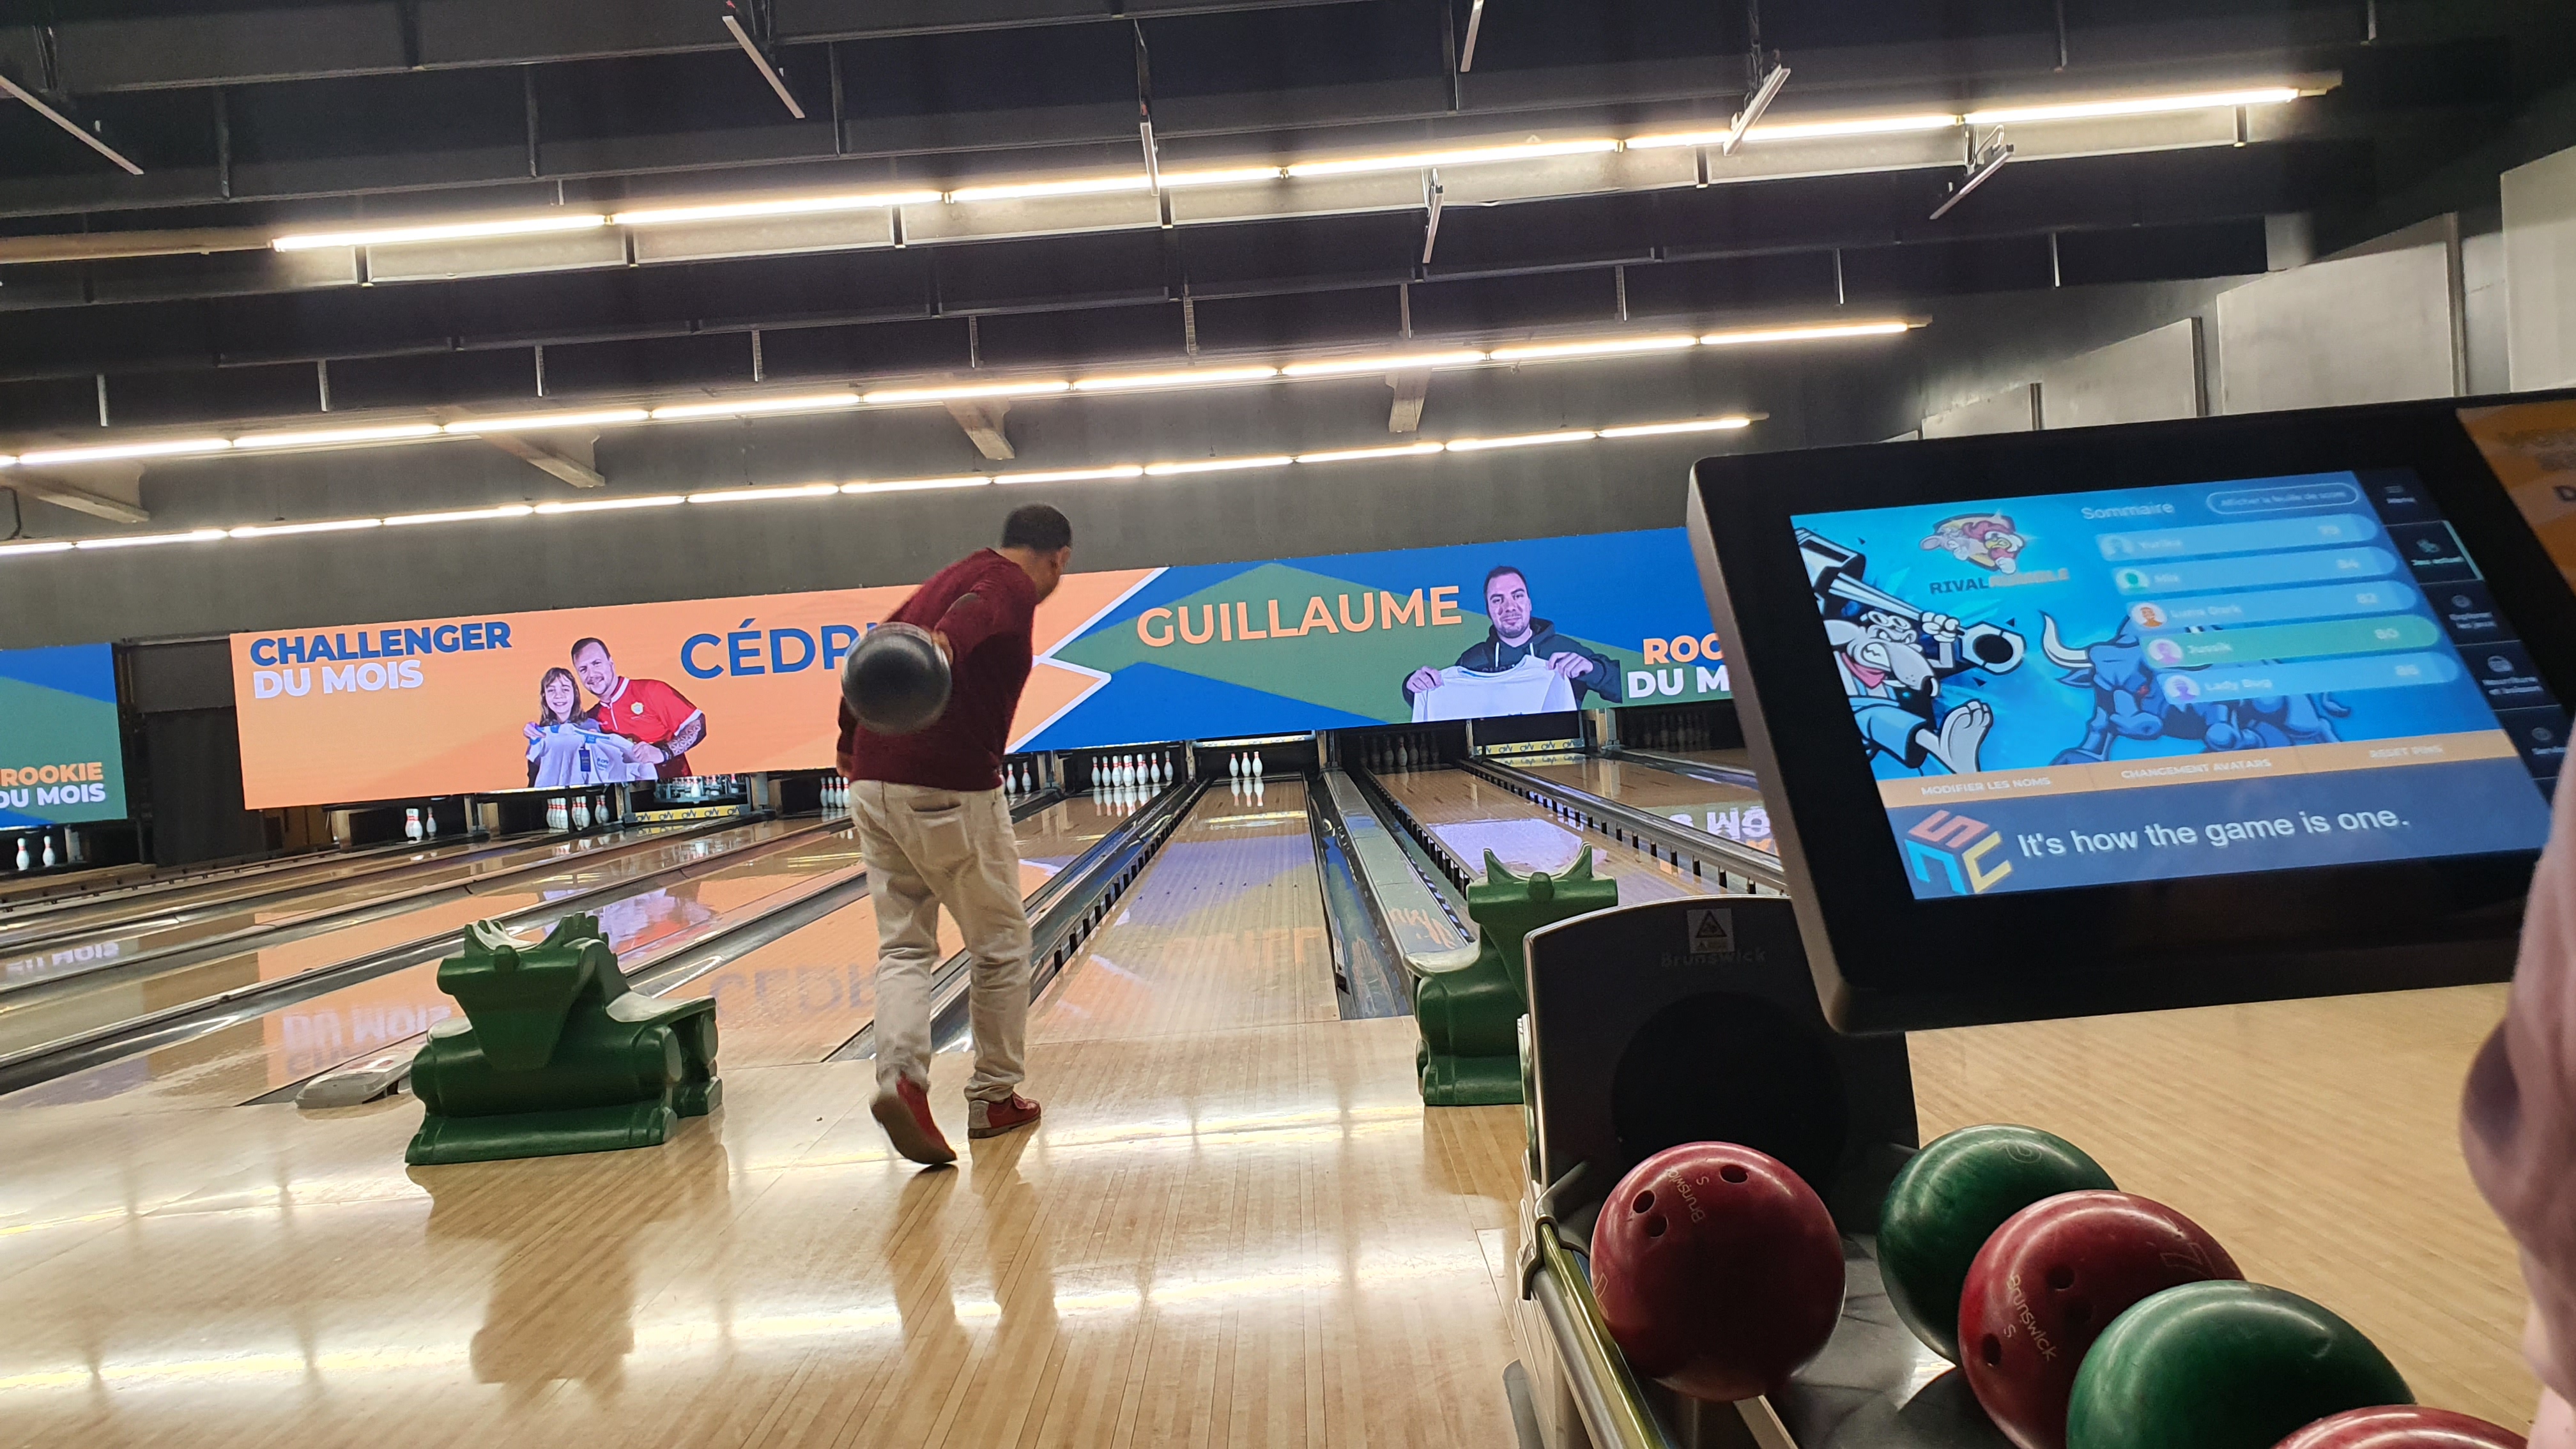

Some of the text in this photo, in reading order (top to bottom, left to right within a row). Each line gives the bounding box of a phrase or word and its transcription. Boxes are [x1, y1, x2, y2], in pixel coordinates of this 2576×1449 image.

[2081, 502, 2174, 520] Sommaire
[1929, 577, 1989, 595] RIVAL
[1137, 585, 1462, 648] GUILLAUME
[250, 621, 512, 666] CHALLENGER
[680, 618, 877, 679] CÉDR
[253, 659, 424, 699] DU MOIS
[1627, 668, 1684, 698] DU
[2369, 747, 2408, 759] RESET
[0, 762, 104, 787] ROOKIE
[2121, 758, 2271, 779] CHANGEMENT AVATARS
[36, 783, 106, 806] MOIS
[1921, 778, 2051, 796] MODIFIER LES NOMS
[2017, 809, 2411, 857] It's how the game is one.
[2007, 1274, 2057, 1361] Brunswick
